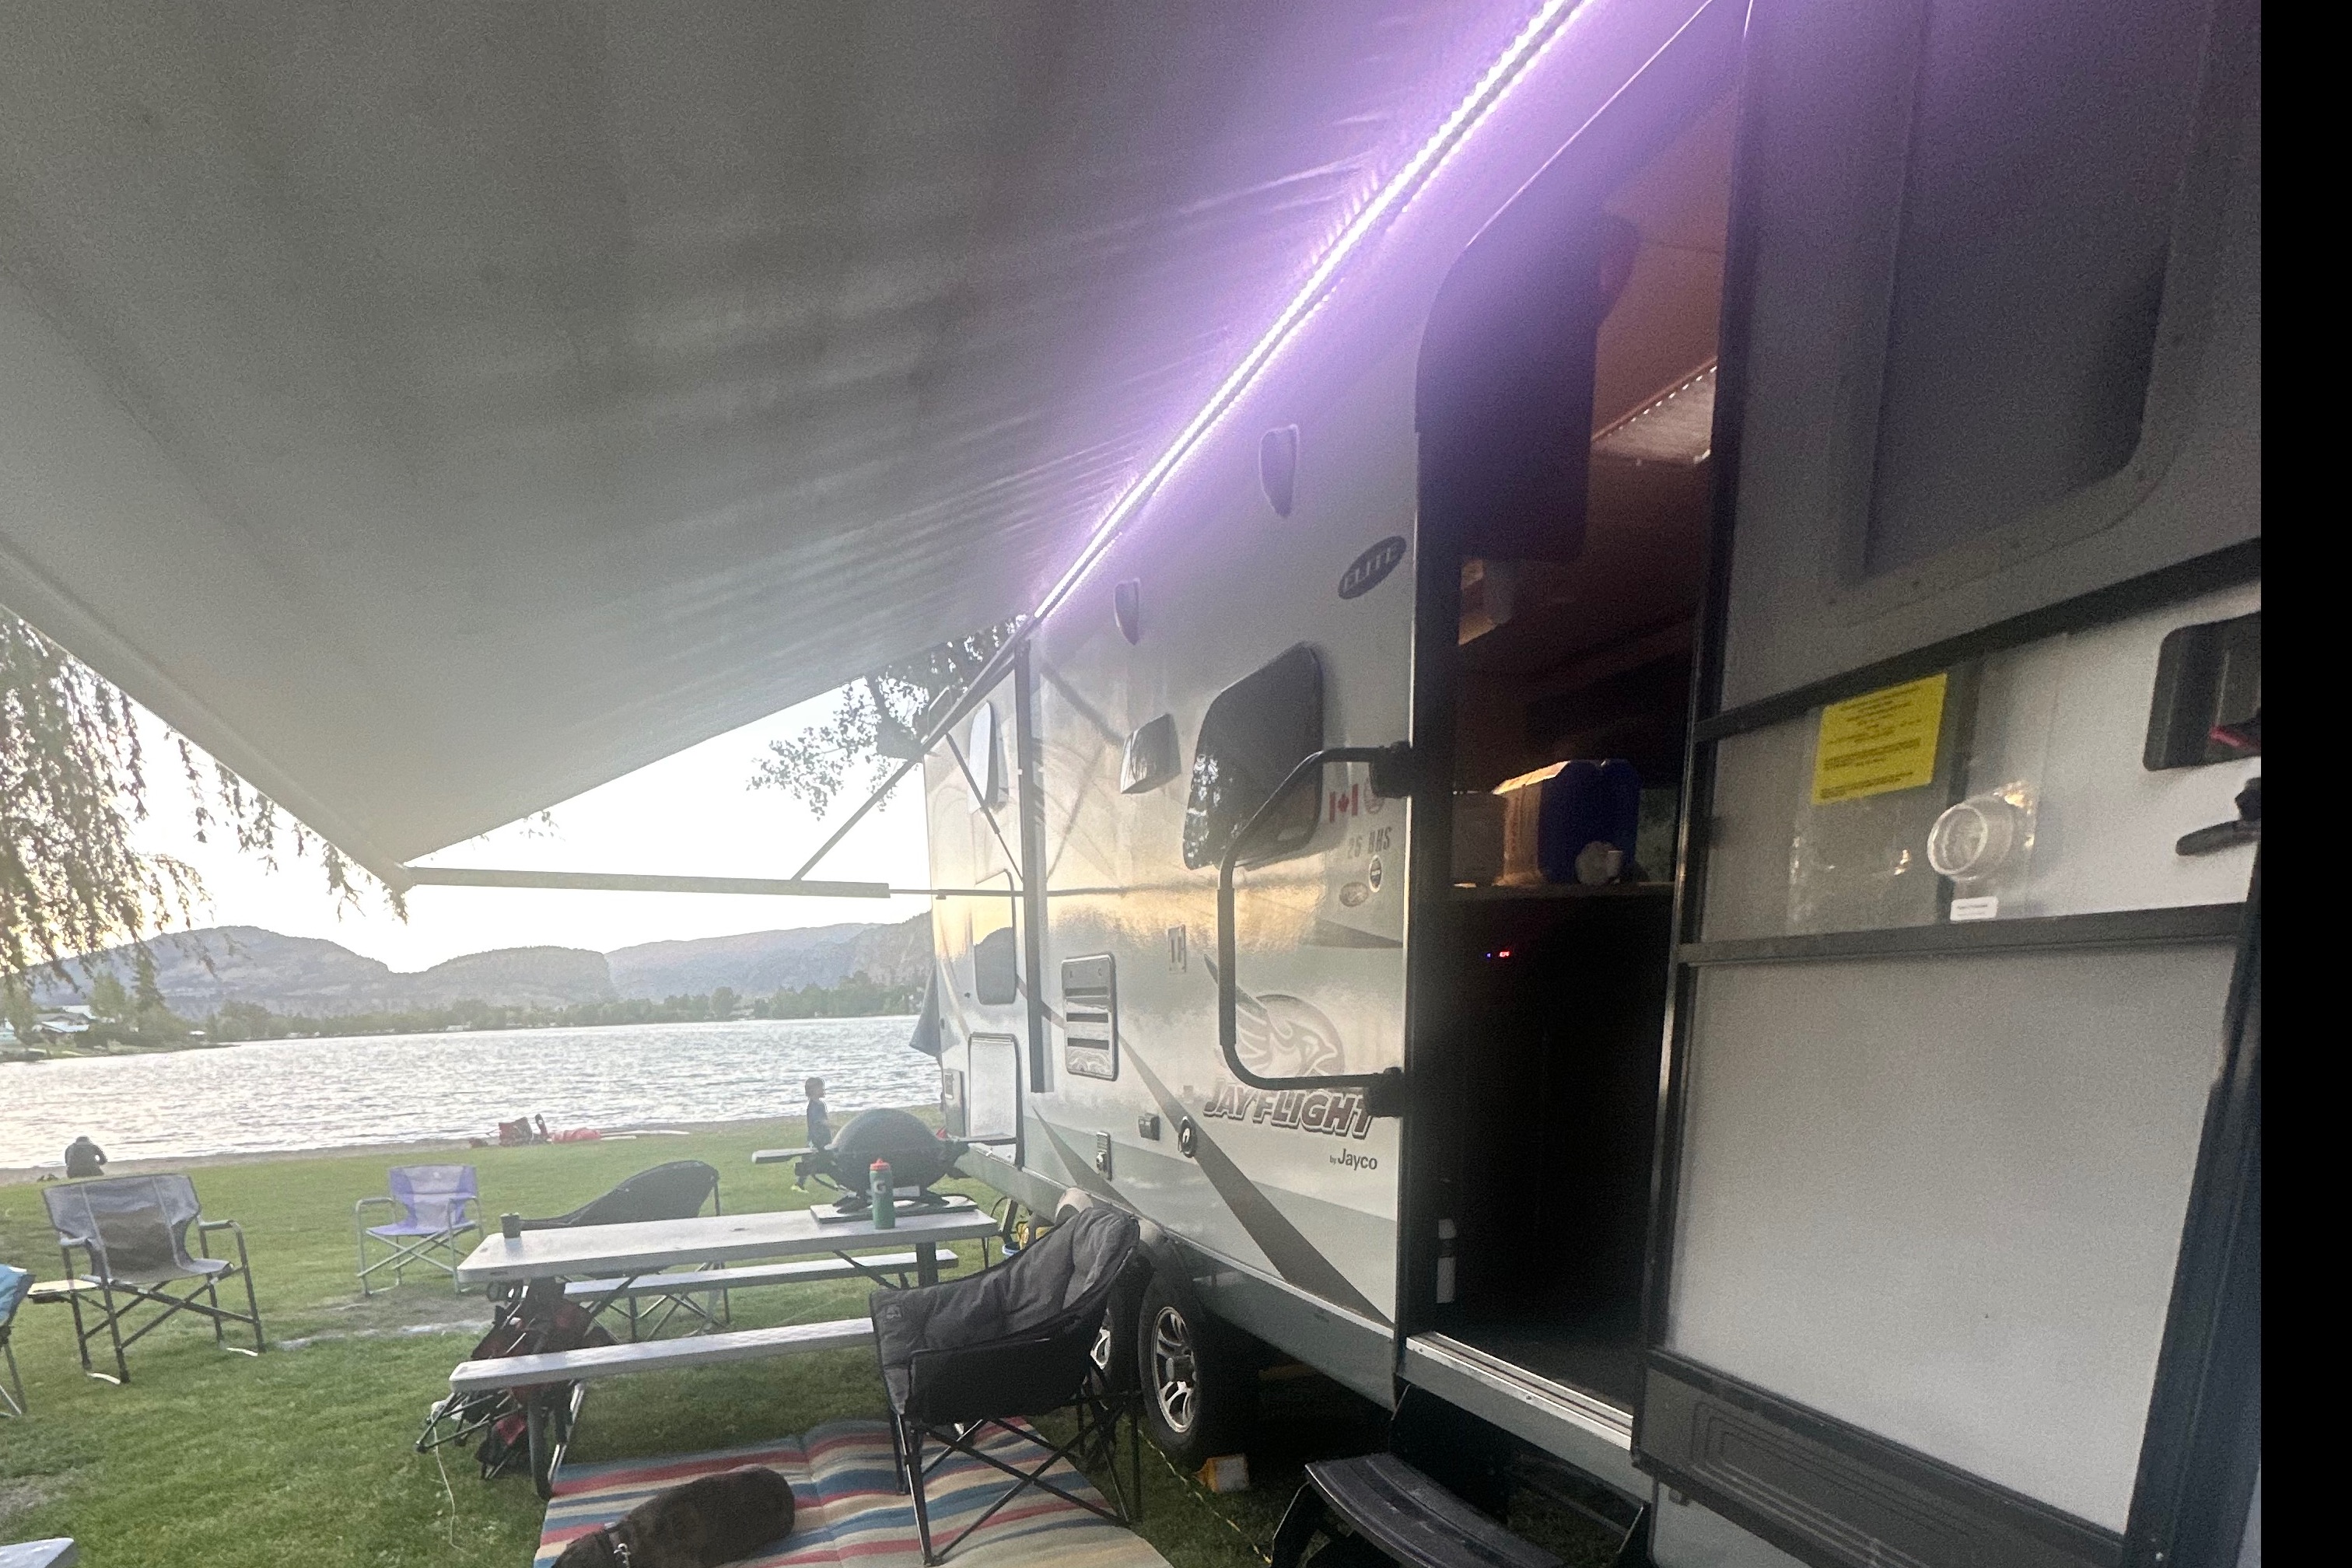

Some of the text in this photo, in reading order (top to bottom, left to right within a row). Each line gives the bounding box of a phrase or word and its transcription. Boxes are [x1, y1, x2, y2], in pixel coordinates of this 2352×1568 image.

[1367, 826, 1393, 854] BHS
[1329, 1148, 1377, 1171] by Jayco
[873, 1180, 887, 1195] G
